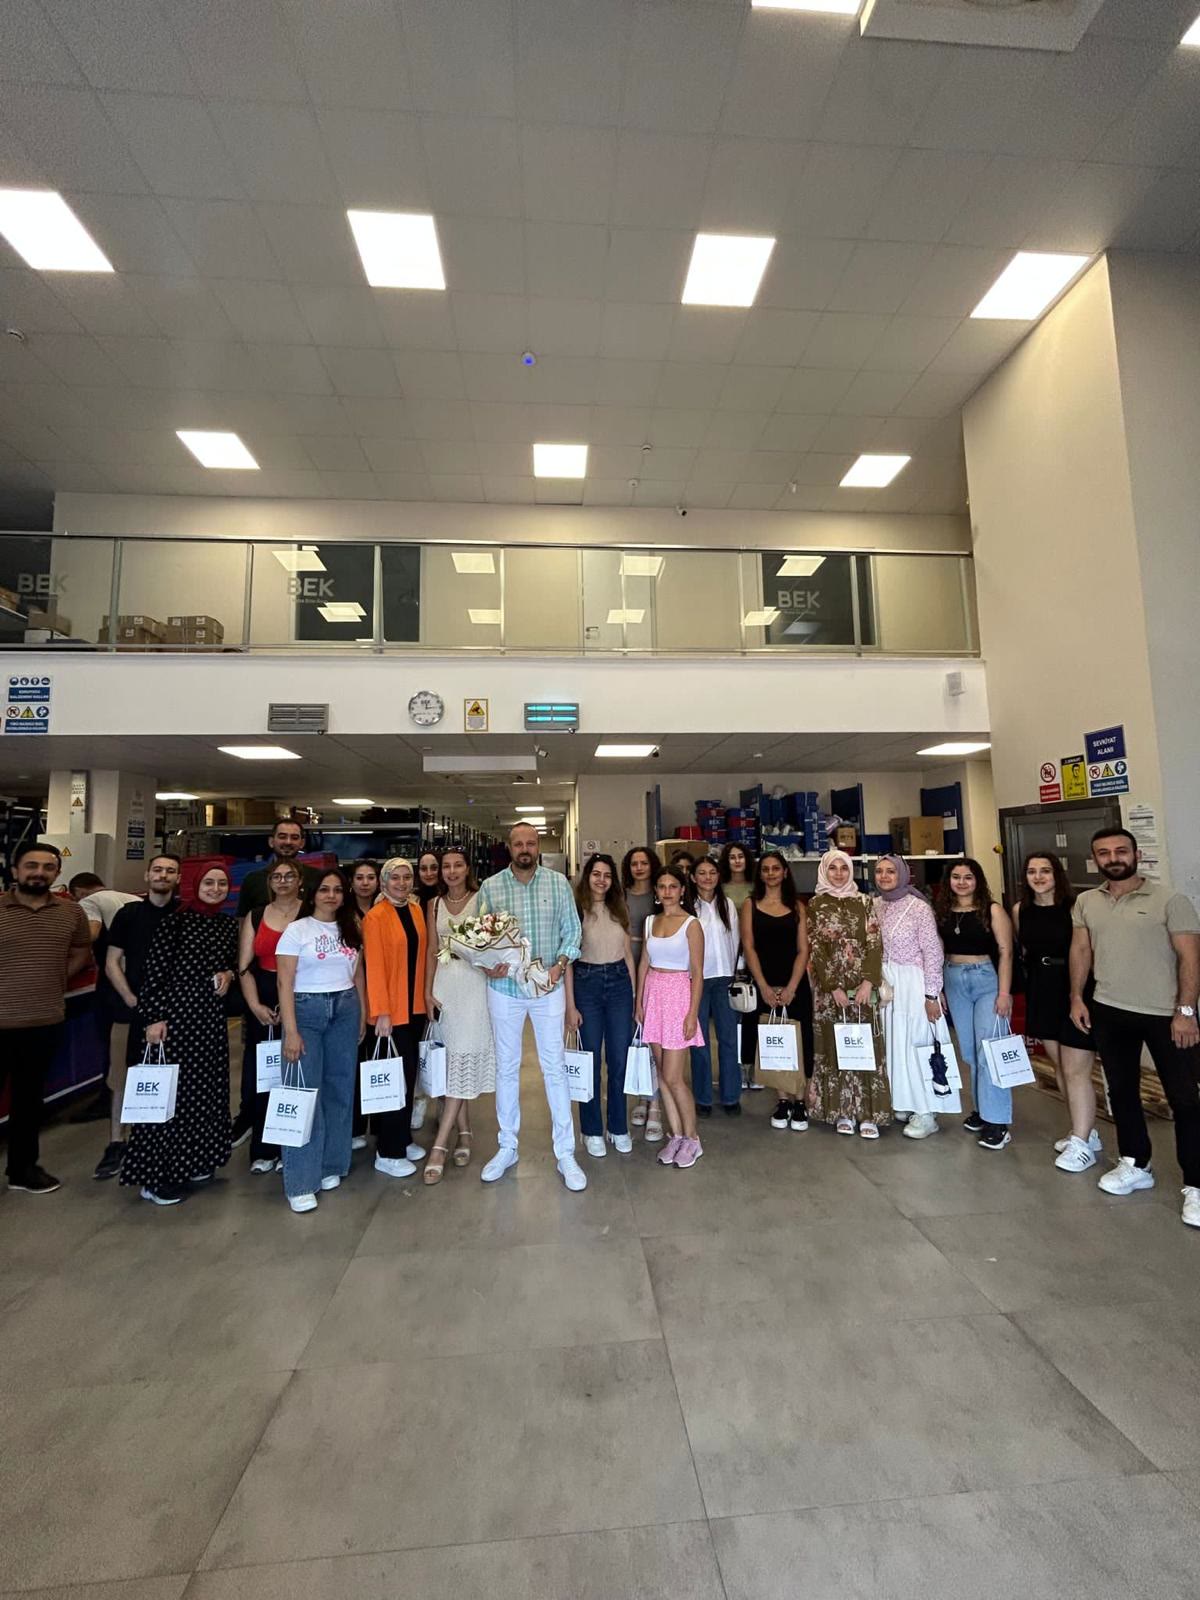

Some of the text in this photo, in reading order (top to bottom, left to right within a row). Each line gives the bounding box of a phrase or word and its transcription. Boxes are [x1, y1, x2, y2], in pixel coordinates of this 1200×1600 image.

[287, 577, 335, 597] BEK
[778, 590, 821, 608] BEK
[766, 1036, 784, 1045] BEK
[844, 1036, 864, 1045] BEK
[266, 1054, 281, 1065] BE
[1001, 1050, 1020, 1061] BEK
[370, 1073, 391, 1085] BEK
[136, 1081, 160, 1092] BEK
[277, 1103, 298, 1115] BEK
